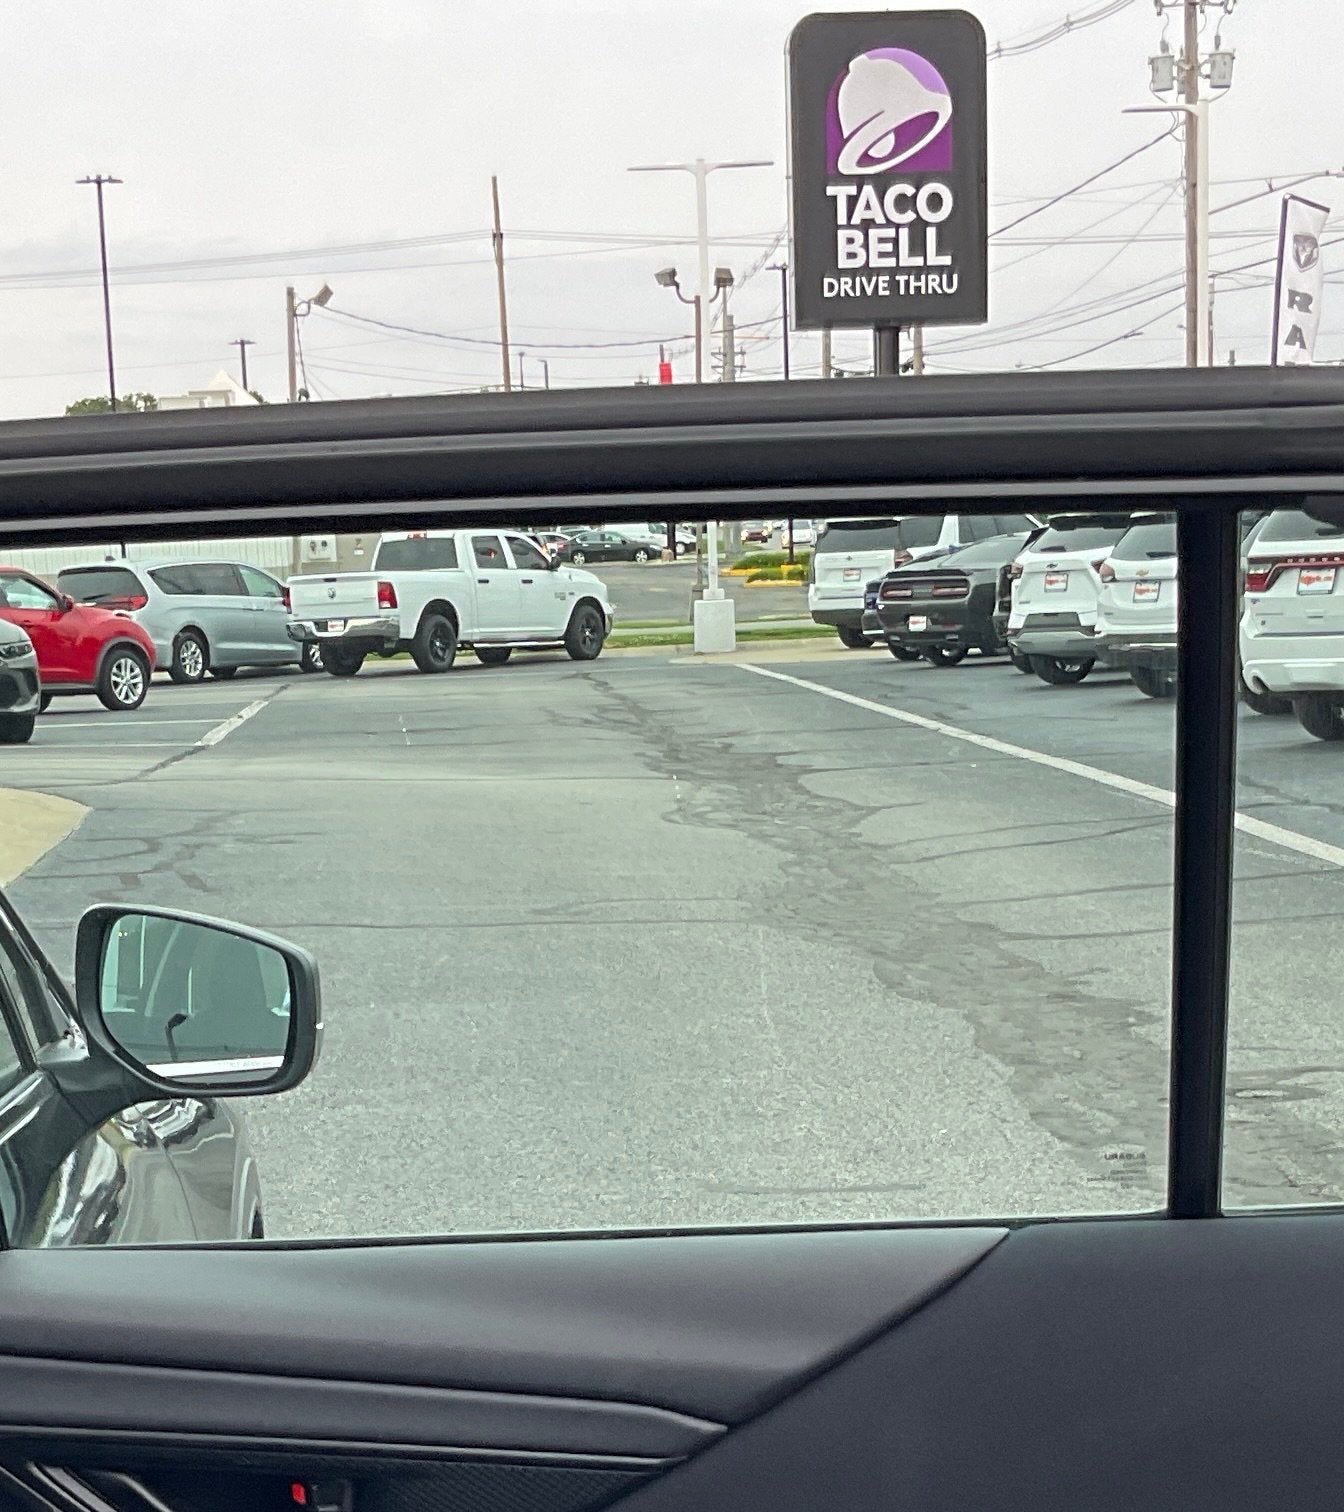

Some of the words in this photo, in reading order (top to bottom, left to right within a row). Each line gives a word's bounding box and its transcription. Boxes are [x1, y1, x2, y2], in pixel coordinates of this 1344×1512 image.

[826, 183, 954, 226] TACO
[837, 227, 952, 269] BELL
[823, 275, 890, 298] DRIVE
[895, 274, 958, 296] THRU
[1283, 288, 1314, 366] RA
